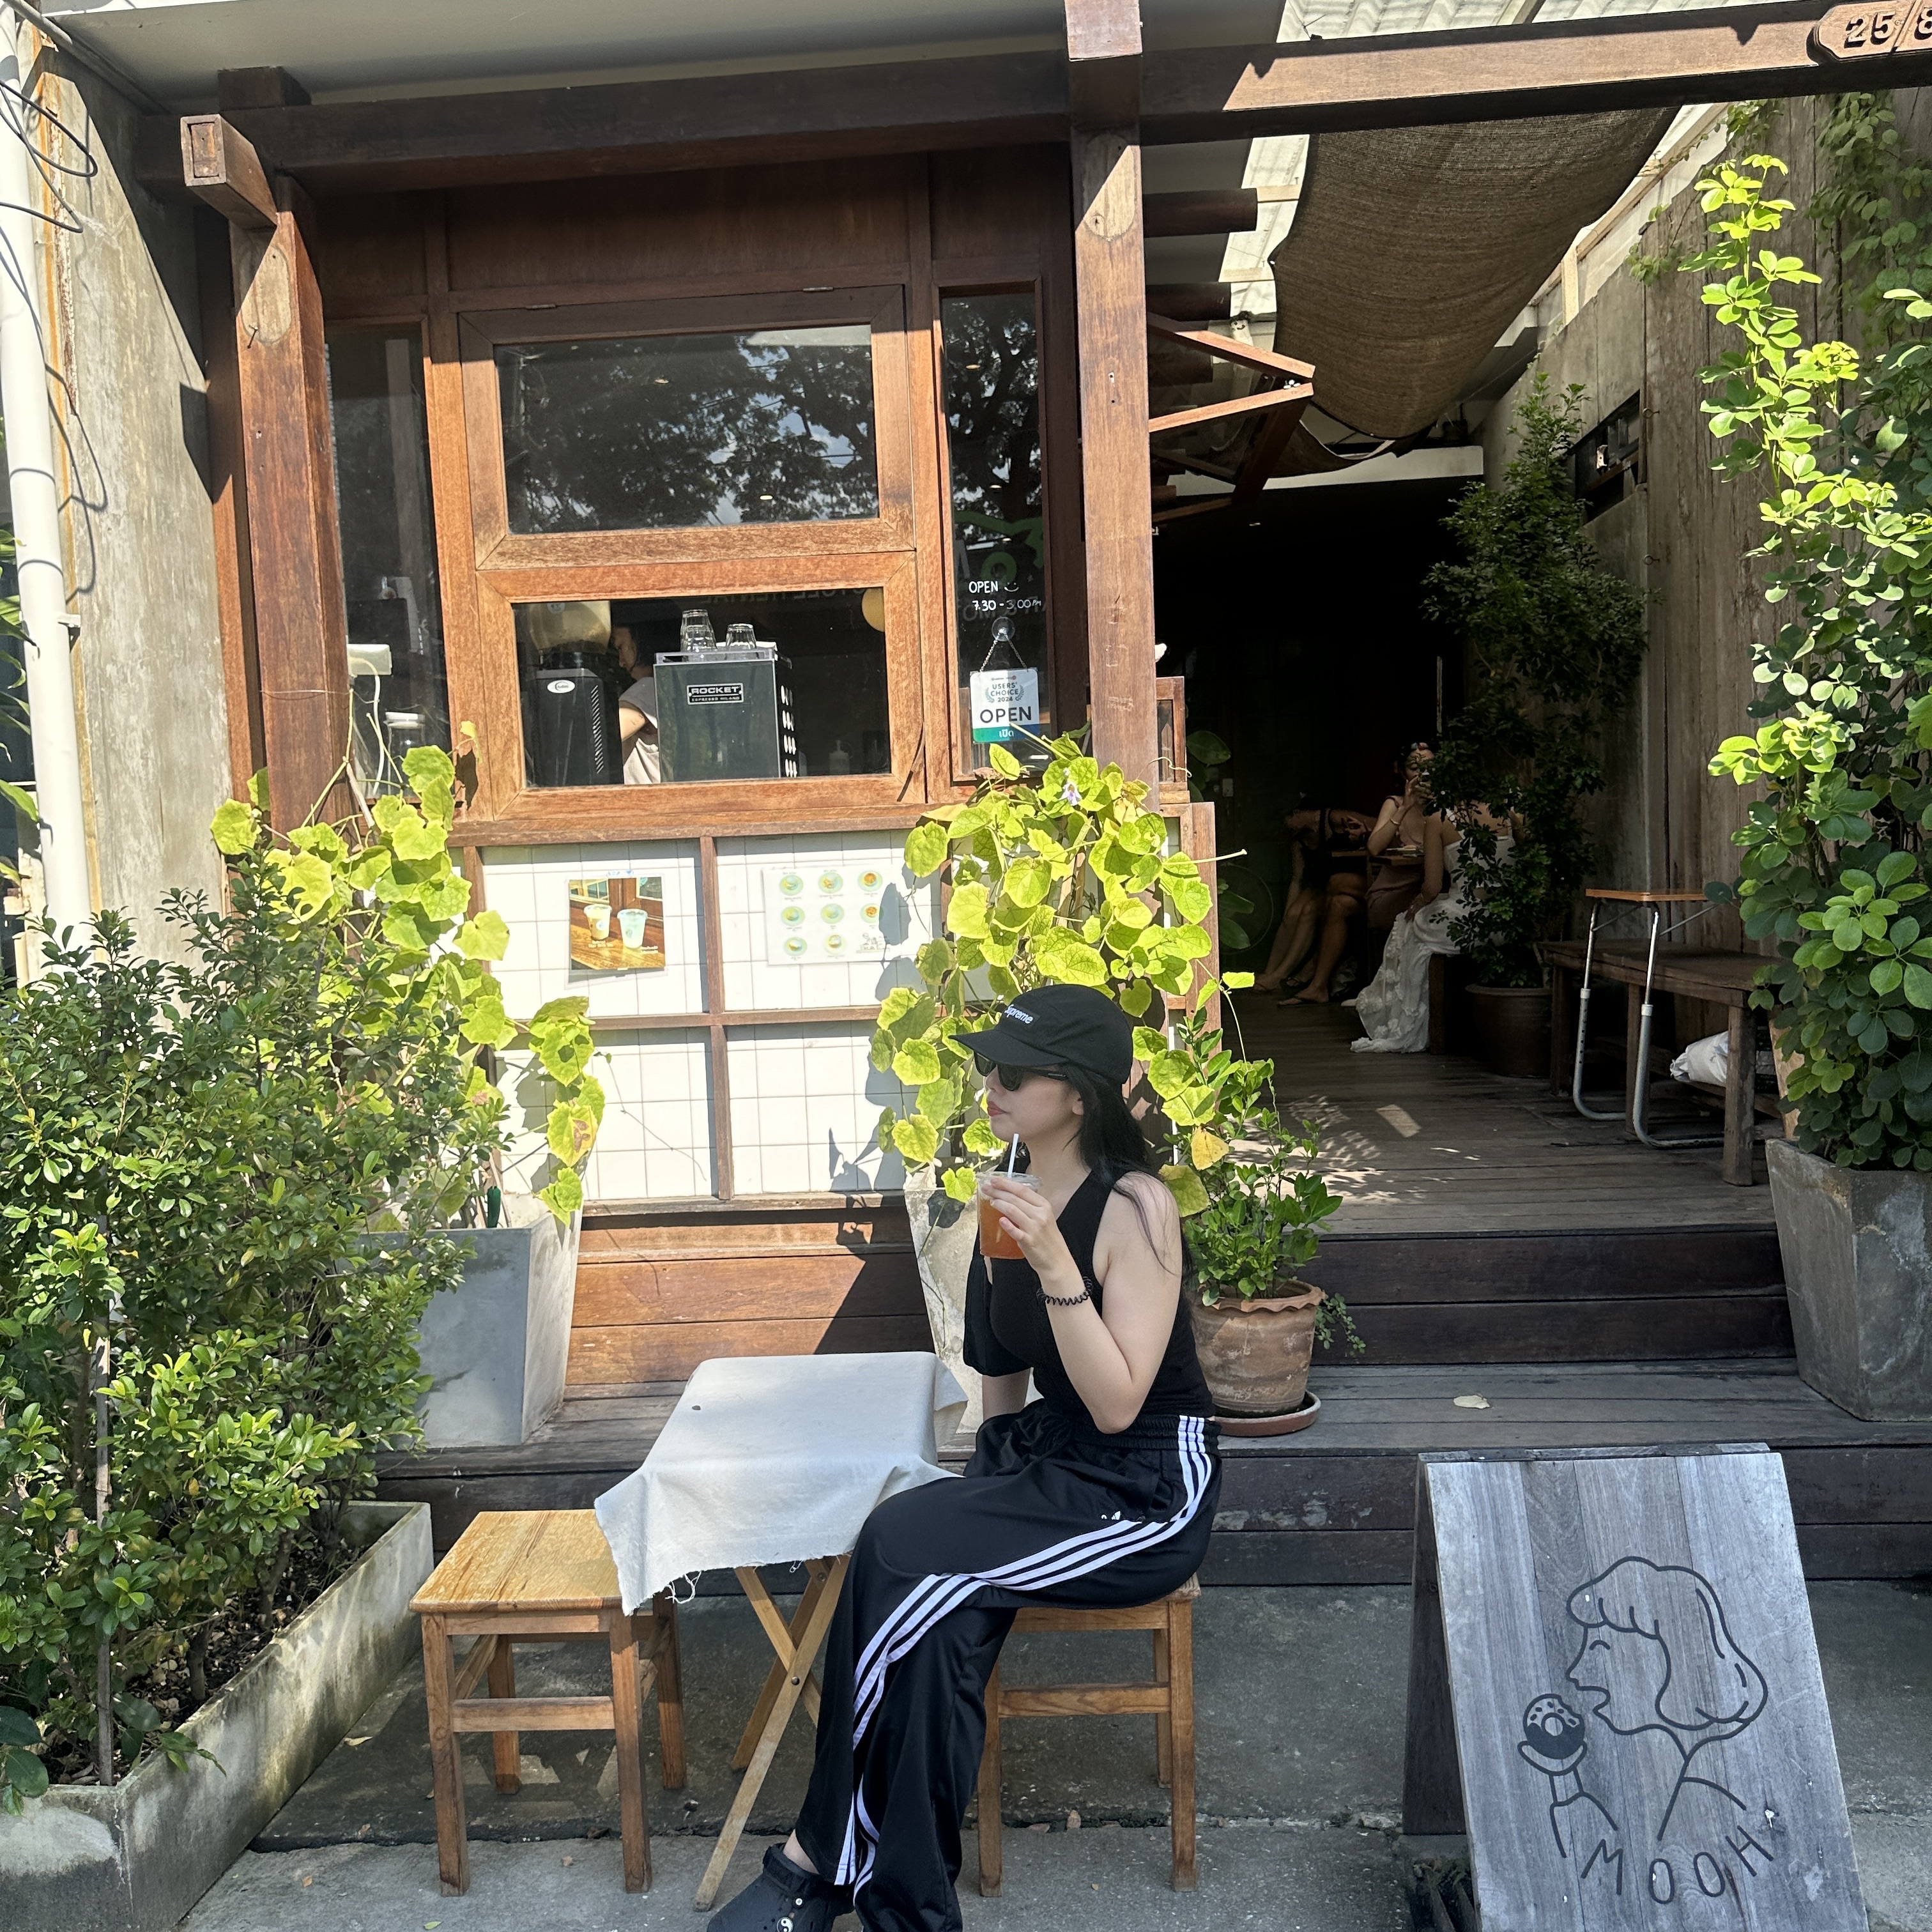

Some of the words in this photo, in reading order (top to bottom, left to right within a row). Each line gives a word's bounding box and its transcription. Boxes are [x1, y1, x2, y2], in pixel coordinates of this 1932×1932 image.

[969, 580, 999, 594] OPEN
[972, 599, 997, 611] 7.30
[691, 686, 740, 694] ROCKET
[980, 706, 1032, 723] OPEN
[999, 728, 1015, 738] เปิด
[1004, 1004, 1034, 1024] Supreme
[1581, 1825, 1774, 1905] MOOH
